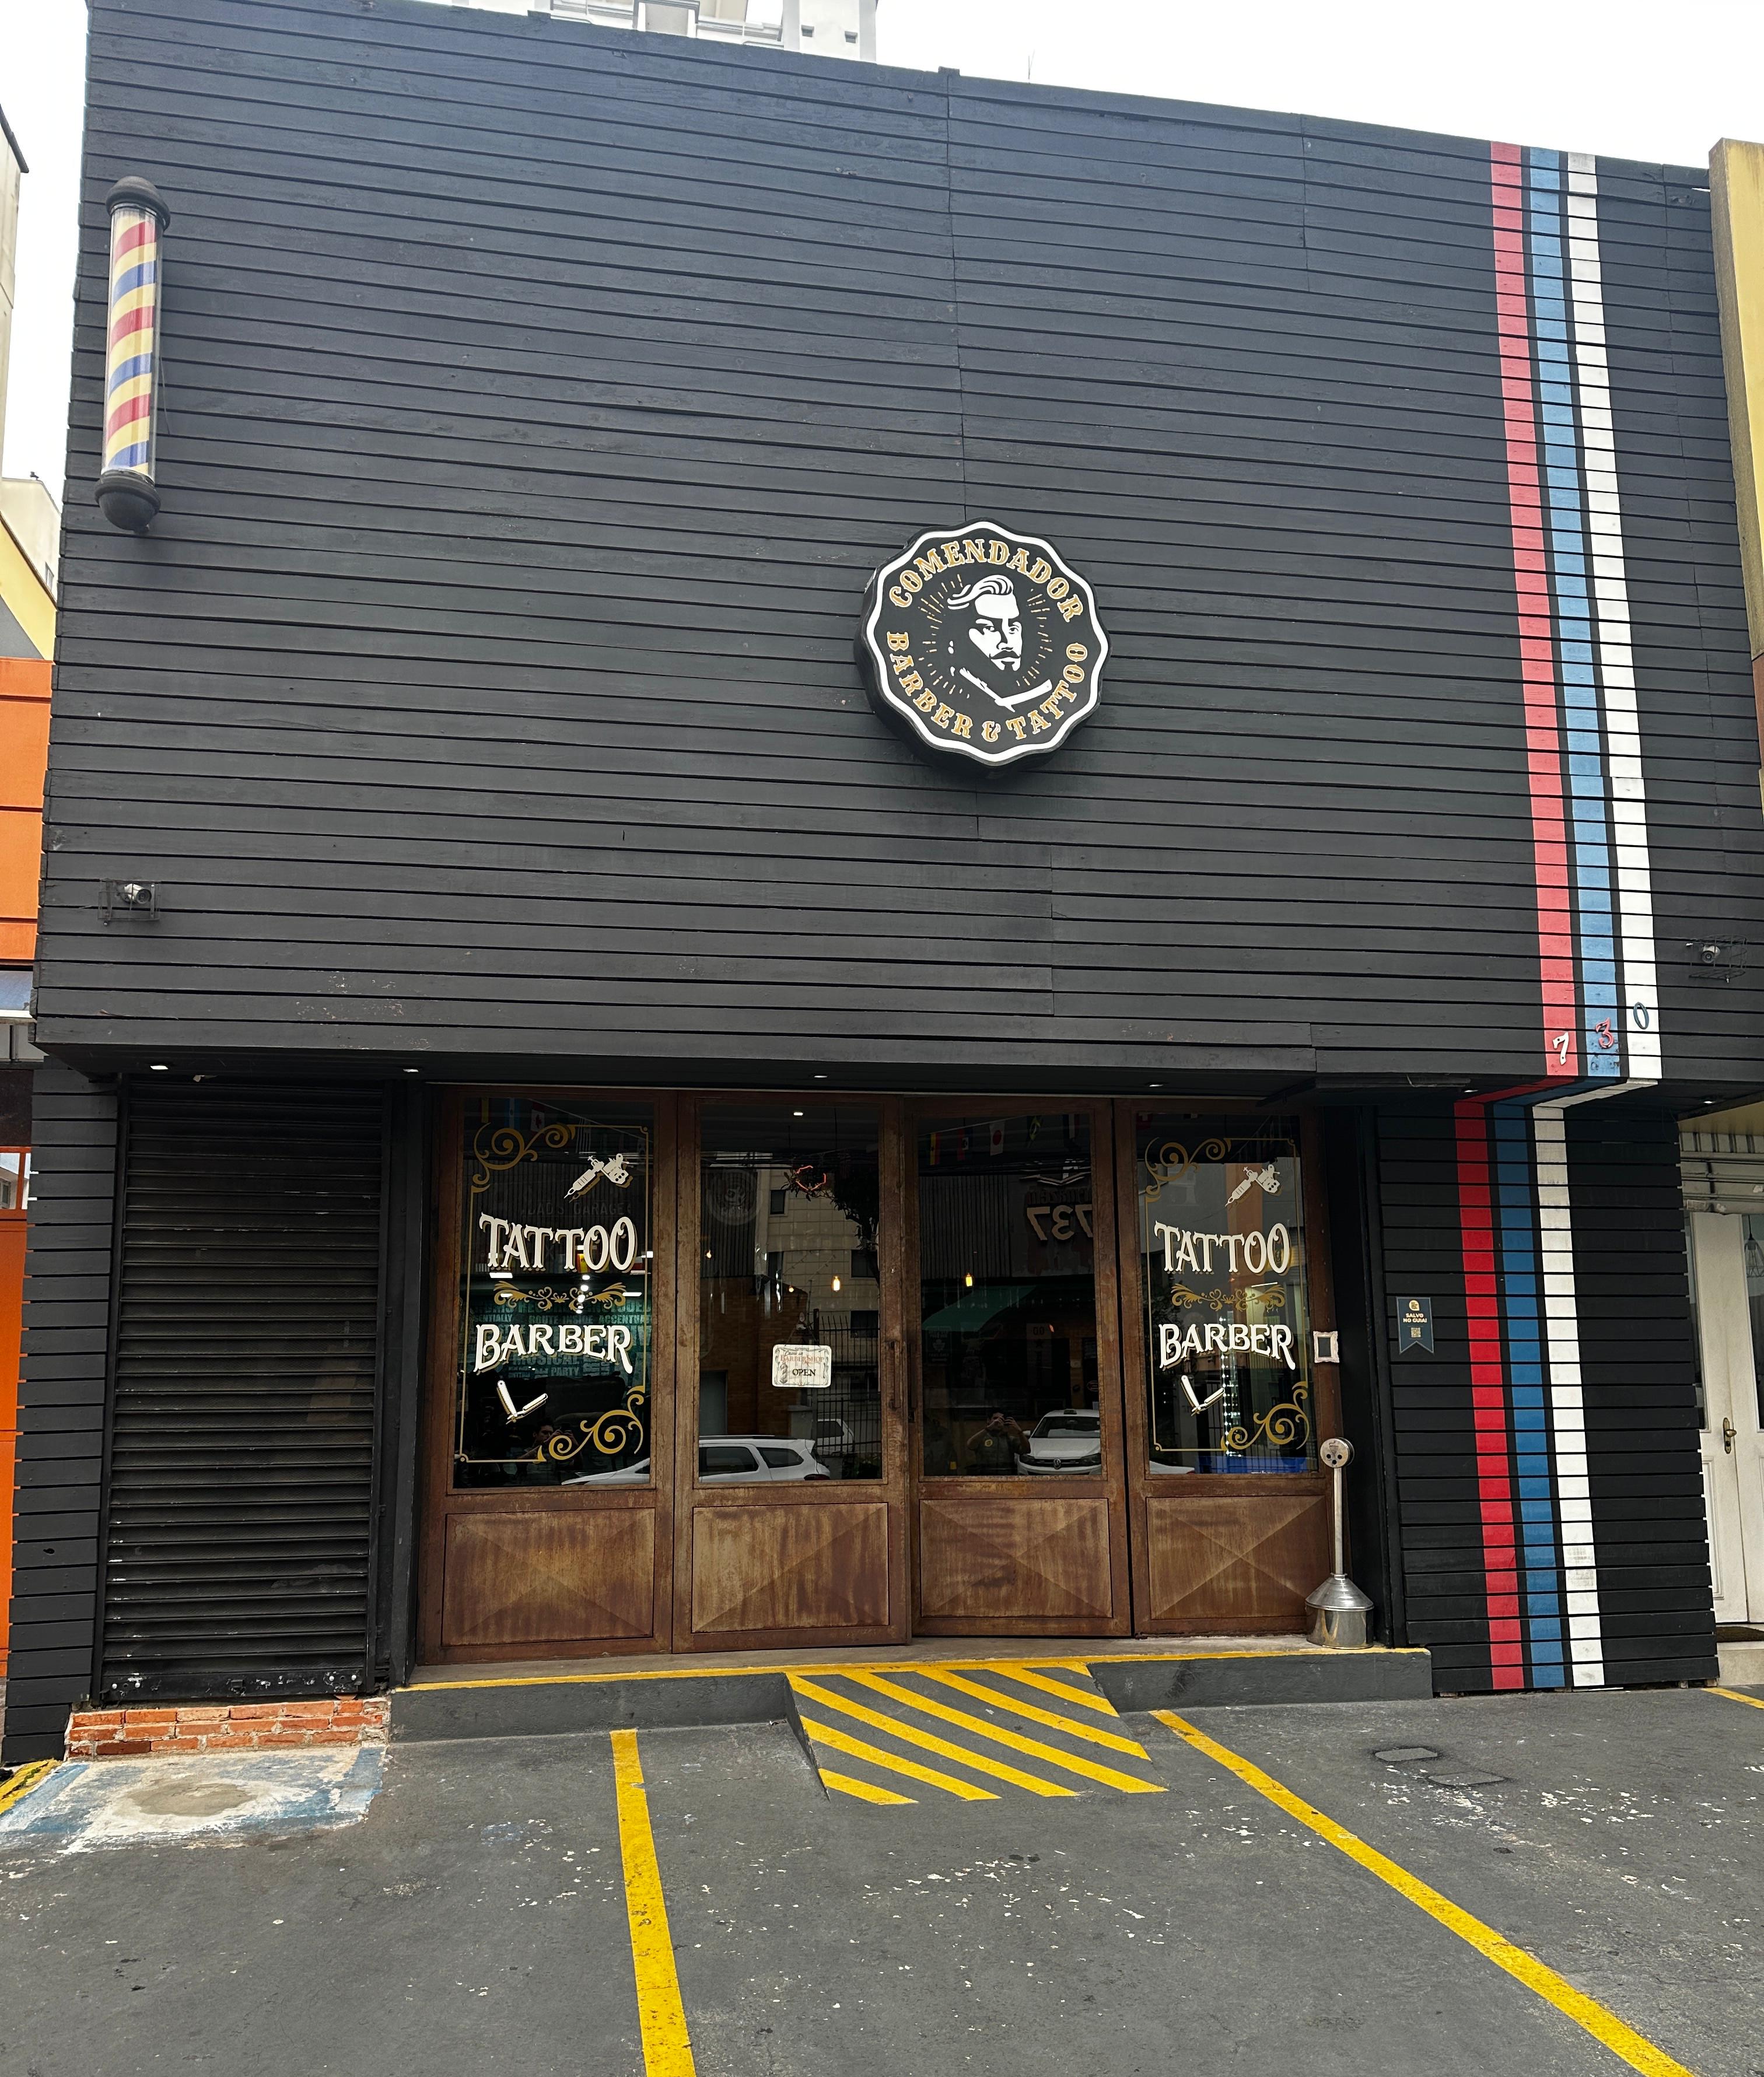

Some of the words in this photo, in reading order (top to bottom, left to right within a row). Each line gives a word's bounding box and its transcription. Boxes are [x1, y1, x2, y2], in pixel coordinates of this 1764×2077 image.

[889, 539, 1083, 622] COMENDADOR
[887, 631, 974, 738] BARBER
[982, 721, 1001, 742] &
[1006, 643, 1088, 741] TATTOO
[479, 1211, 637, 1272] TATTOO
[1154, 1220, 1291, 1274] TATTOO
[473, 1324, 634, 1375] BARBER
[1158, 1323, 1296, 1370] BARBER
